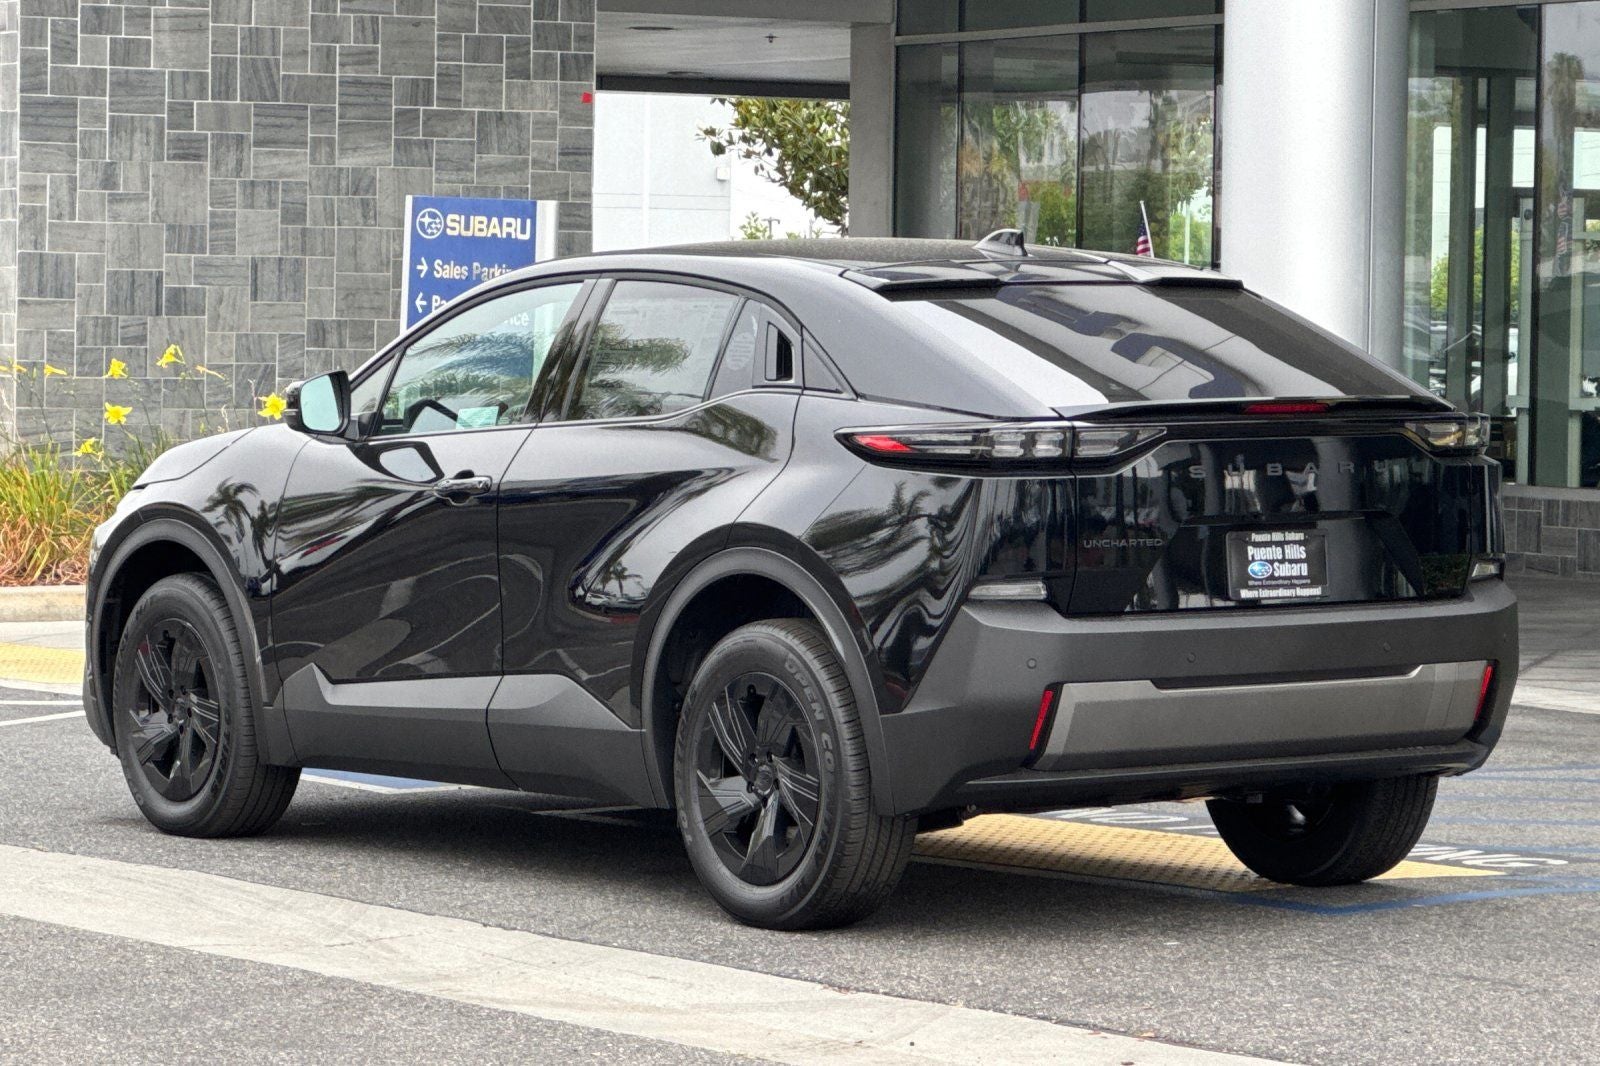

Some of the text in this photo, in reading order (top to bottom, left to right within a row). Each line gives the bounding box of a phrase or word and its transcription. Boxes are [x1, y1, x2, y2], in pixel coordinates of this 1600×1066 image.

[446, 213, 531, 240] SUBARU
[433, 259, 513, 282] Sales Parki
[1188, 460, 1387, 479] SUBARU
[1083, 537, 1165, 549] UNCHARTED
[1247, 544, 1307, 560] Puente Hills
[1273, 562, 1308, 577] Subaru
[1240, 588, 1258, 598] Where
[1259, 587, 1296, 598] Extraordinary
